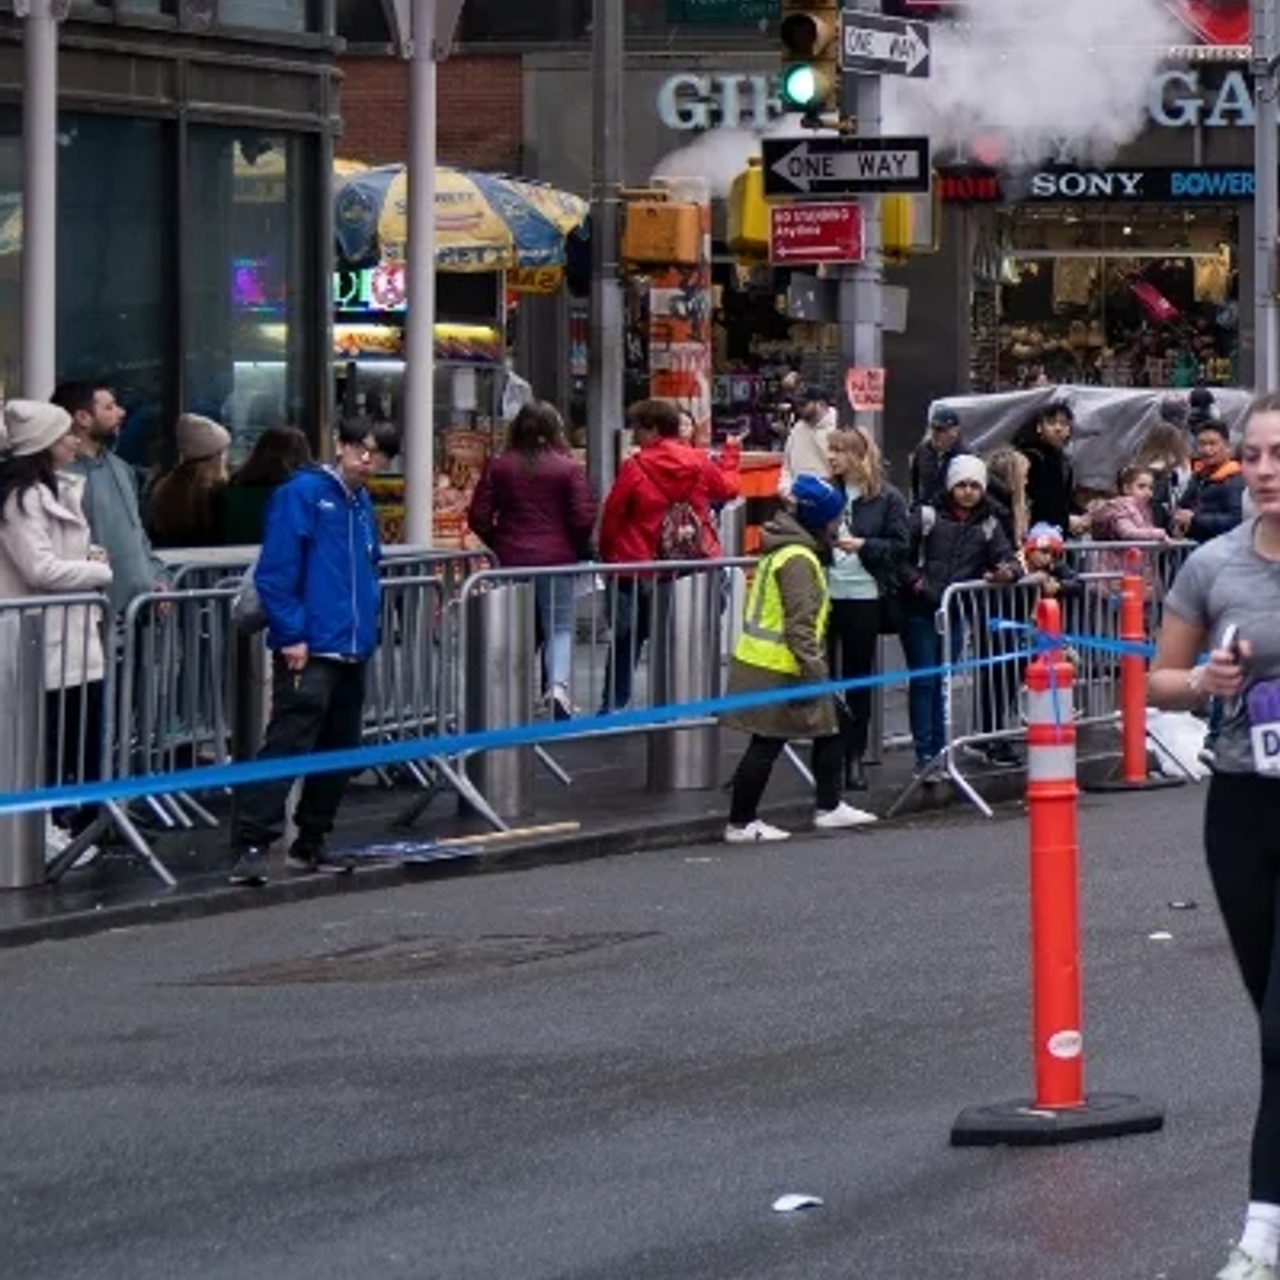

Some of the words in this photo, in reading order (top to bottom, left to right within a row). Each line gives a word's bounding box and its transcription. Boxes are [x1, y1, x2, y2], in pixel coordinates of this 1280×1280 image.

[848, 28, 875, 55] ONE
[889, 37, 917, 59] WAY
[787, 155, 835, 177] ONE
[858, 153, 908, 177] WAY
[1031, 173, 1144, 196] SONY
